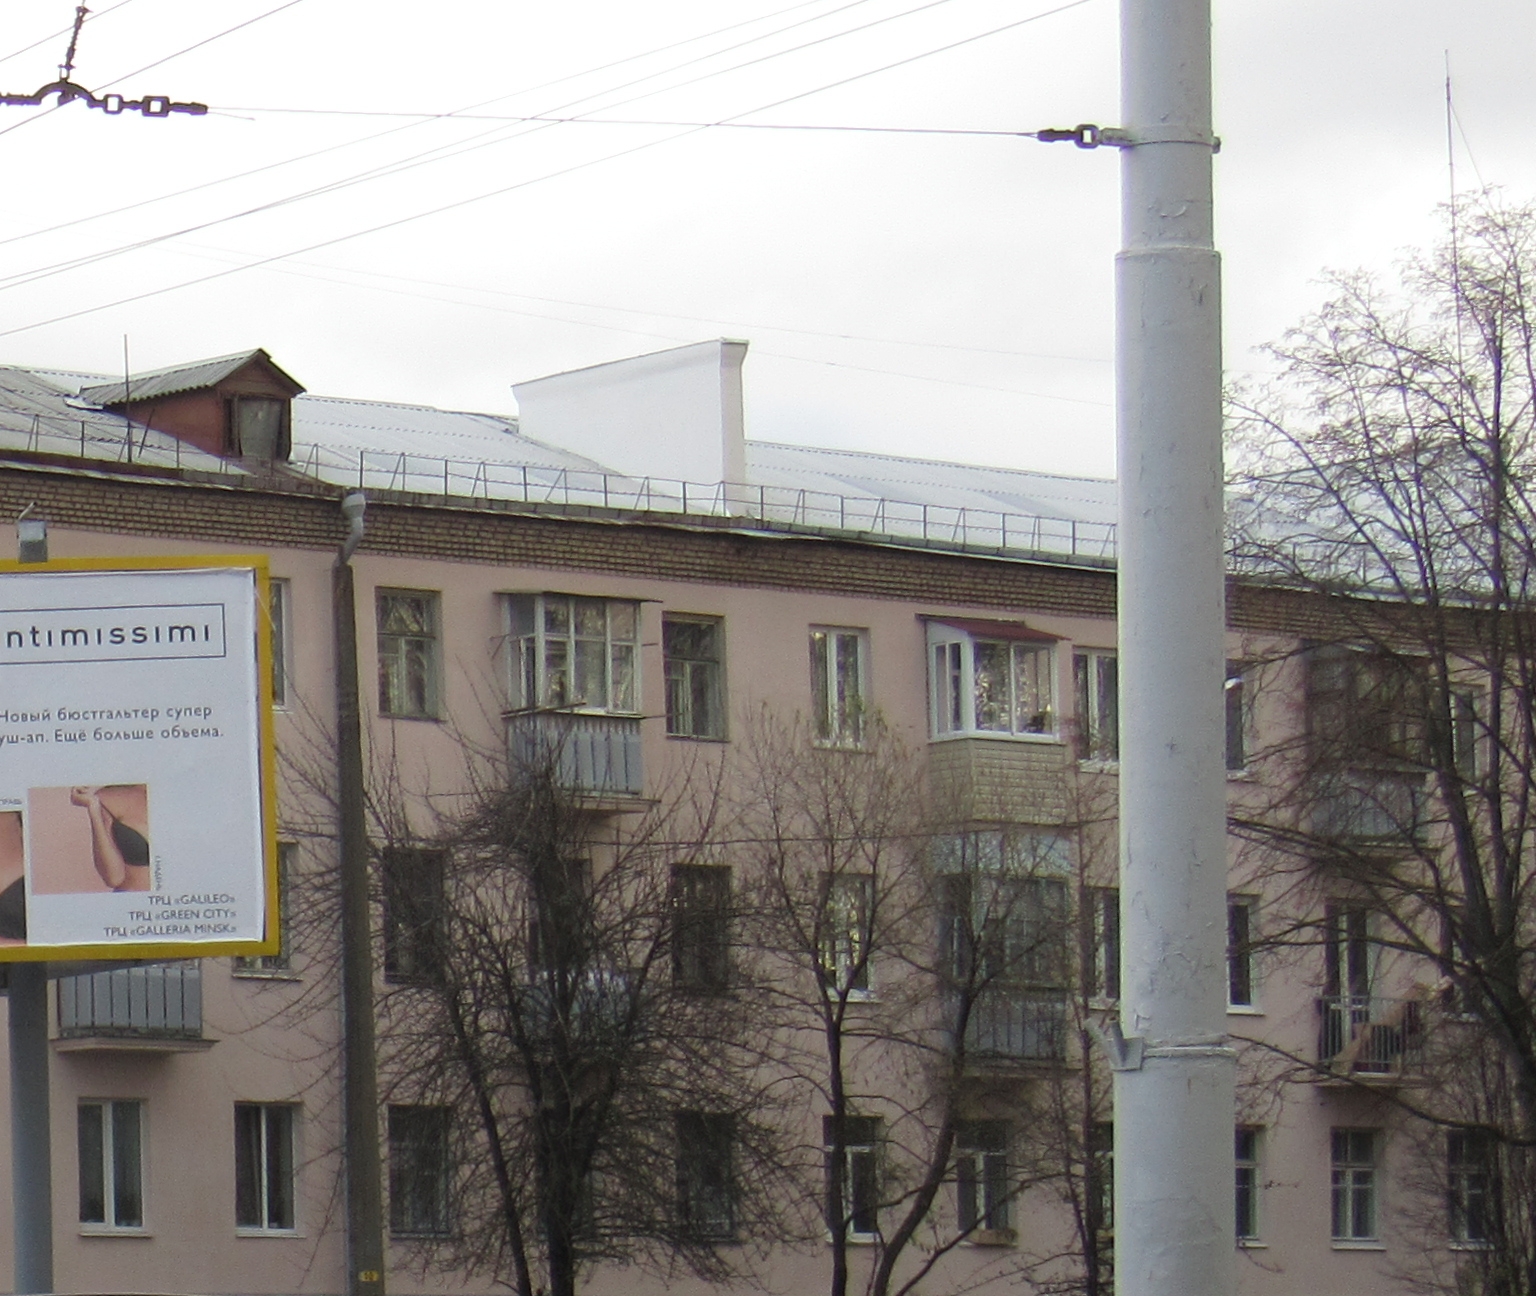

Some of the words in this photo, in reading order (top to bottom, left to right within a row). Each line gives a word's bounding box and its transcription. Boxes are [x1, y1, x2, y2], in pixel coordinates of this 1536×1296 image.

[57, 707, 160, 722] бюстгальтер
[166, 706, 212, 719] супер
[54, 729, 87, 745] Ещё
[93, 727, 154, 742] больше
[160, 725, 224, 739] объема.
[148, 895, 171, 906] ТРЦ
[175, 893, 236, 904] «GALILEO»
[129, 911, 152, 922] ТРЦ
[155, 909, 200, 920] «GREEN
[203, 908, 237, 919] CITY»
[103, 927, 127, 937] ТРЦ
[130, 924, 191, 936] «GALLERIA
[194, 923, 237, 934] MINSK»
